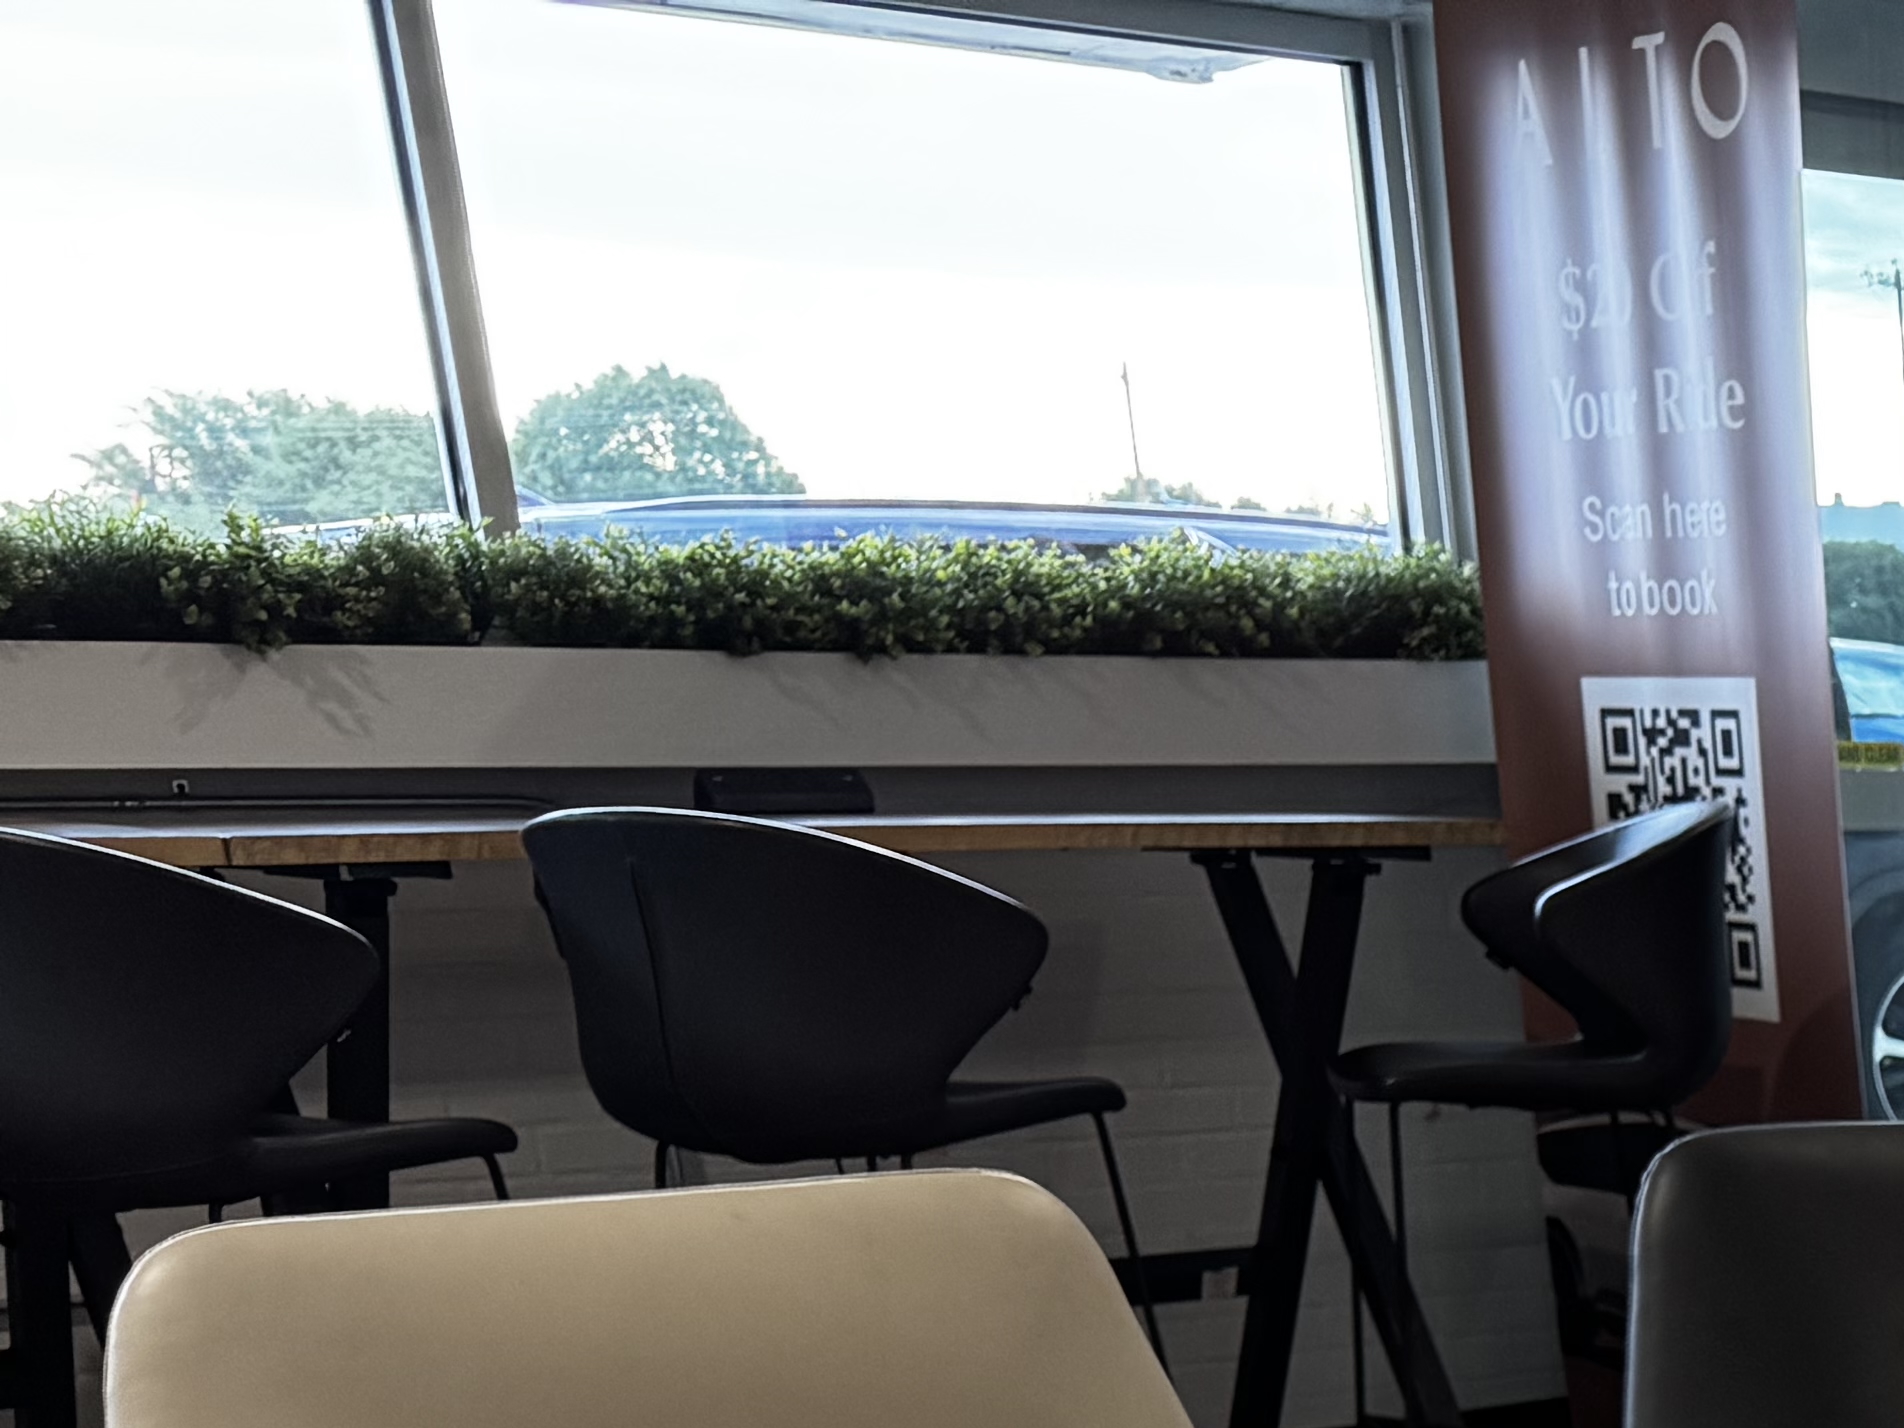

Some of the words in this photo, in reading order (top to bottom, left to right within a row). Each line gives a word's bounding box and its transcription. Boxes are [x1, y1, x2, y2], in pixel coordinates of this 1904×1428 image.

[1650, 239, 1716, 322] Of
[1551, 374, 1638, 441] Your
[1582, 495, 1653, 542] Scan
[1663, 490, 1727, 538] here
[1607, 569, 1637, 617] to
[1639, 568, 1718, 616] book
